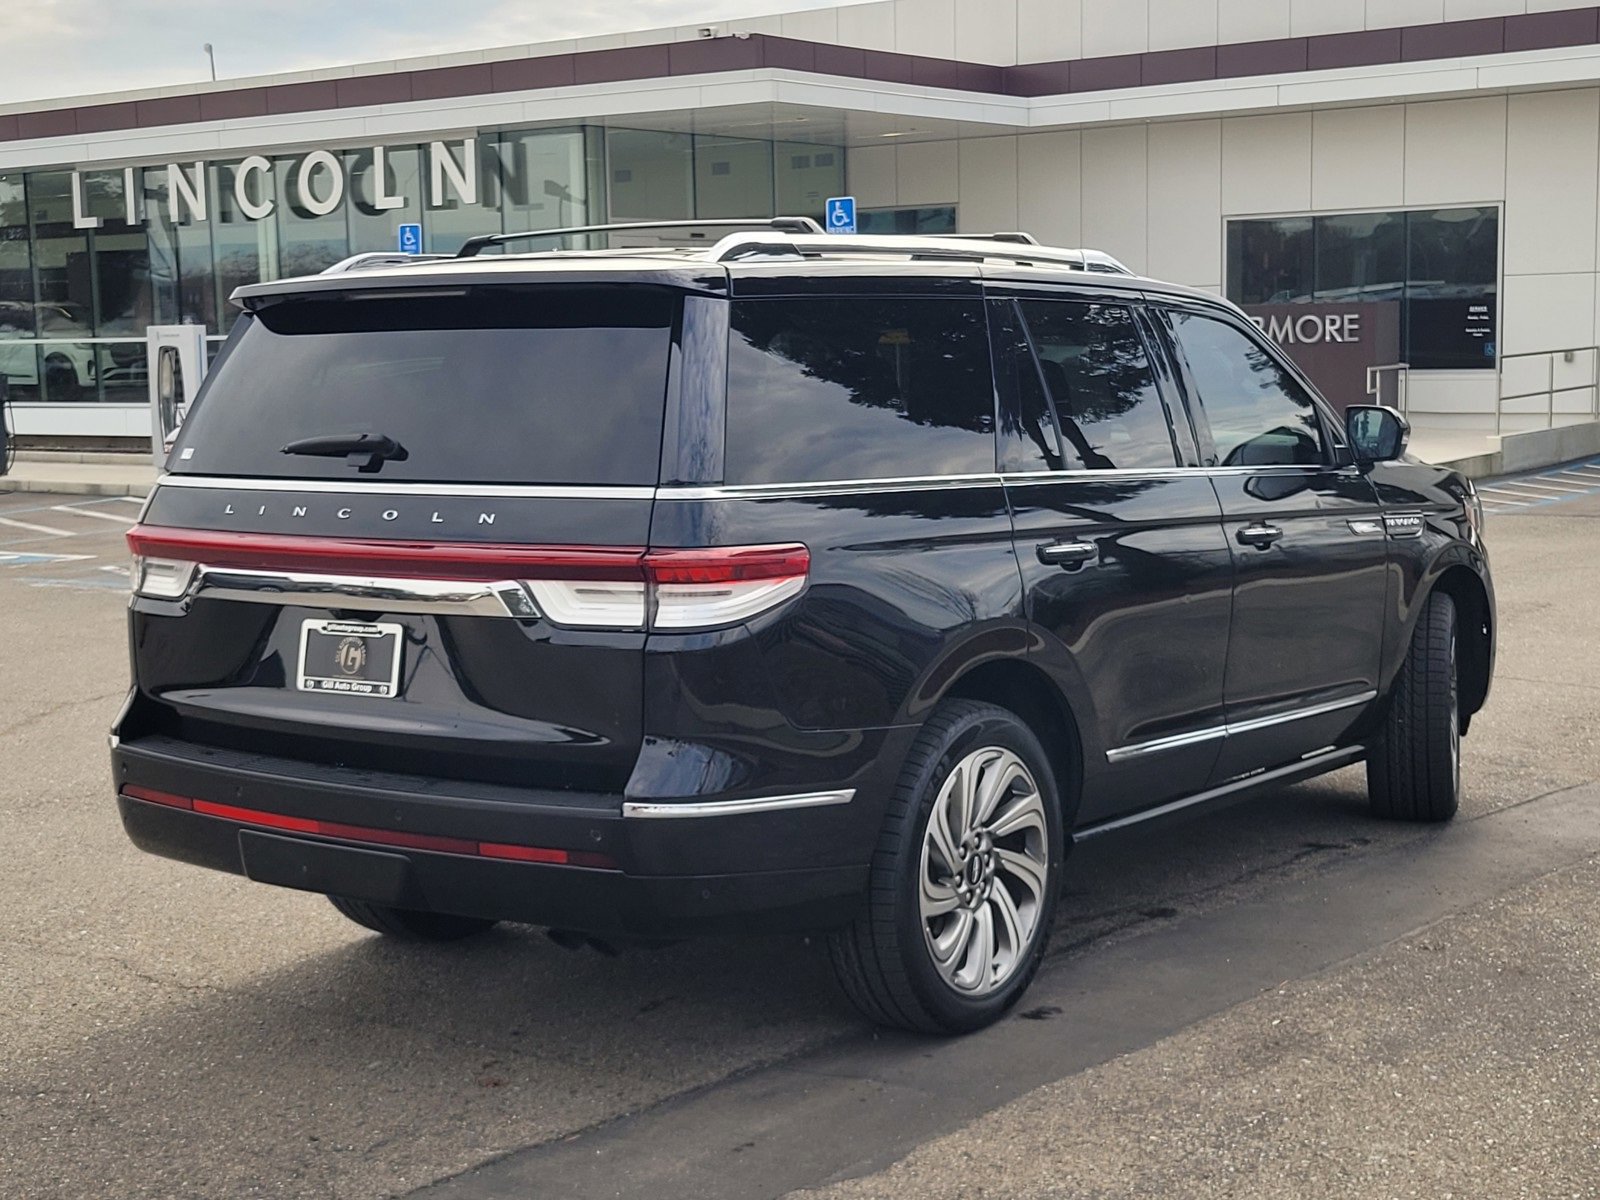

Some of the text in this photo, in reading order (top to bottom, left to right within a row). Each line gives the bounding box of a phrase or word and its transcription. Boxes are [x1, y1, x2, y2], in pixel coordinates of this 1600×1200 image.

[72, 138, 476, 229] LINCOLN
[224, 503, 496, 525] LINCOLN
[322, 681, 372, 693] Gill Auto Group
